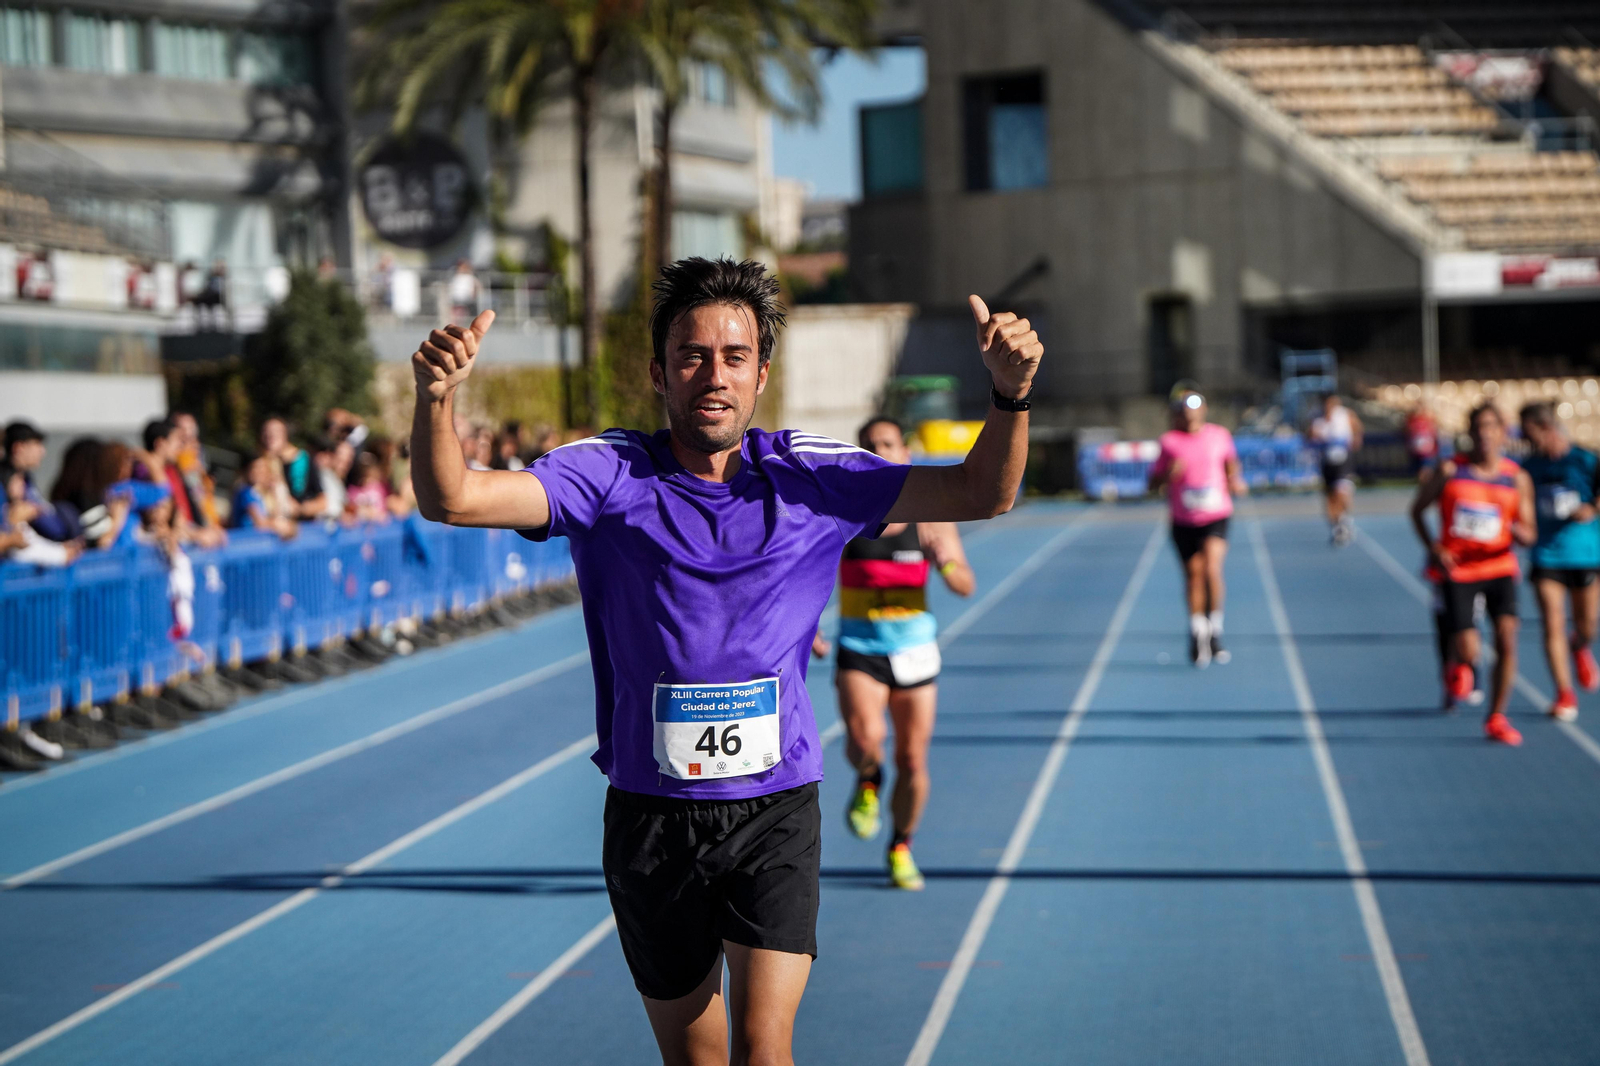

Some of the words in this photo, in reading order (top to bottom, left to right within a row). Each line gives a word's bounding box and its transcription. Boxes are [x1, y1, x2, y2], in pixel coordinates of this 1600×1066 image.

[670, 691, 692, 699] XLIII
[694, 690, 731, 699] Carrera
[733, 686, 765, 698] Popular
[681, 702, 715, 711] Ciudad
[717, 702, 730, 710] de
[731, 700, 756, 710] Jerez
[695, 723, 742, 757] 46
